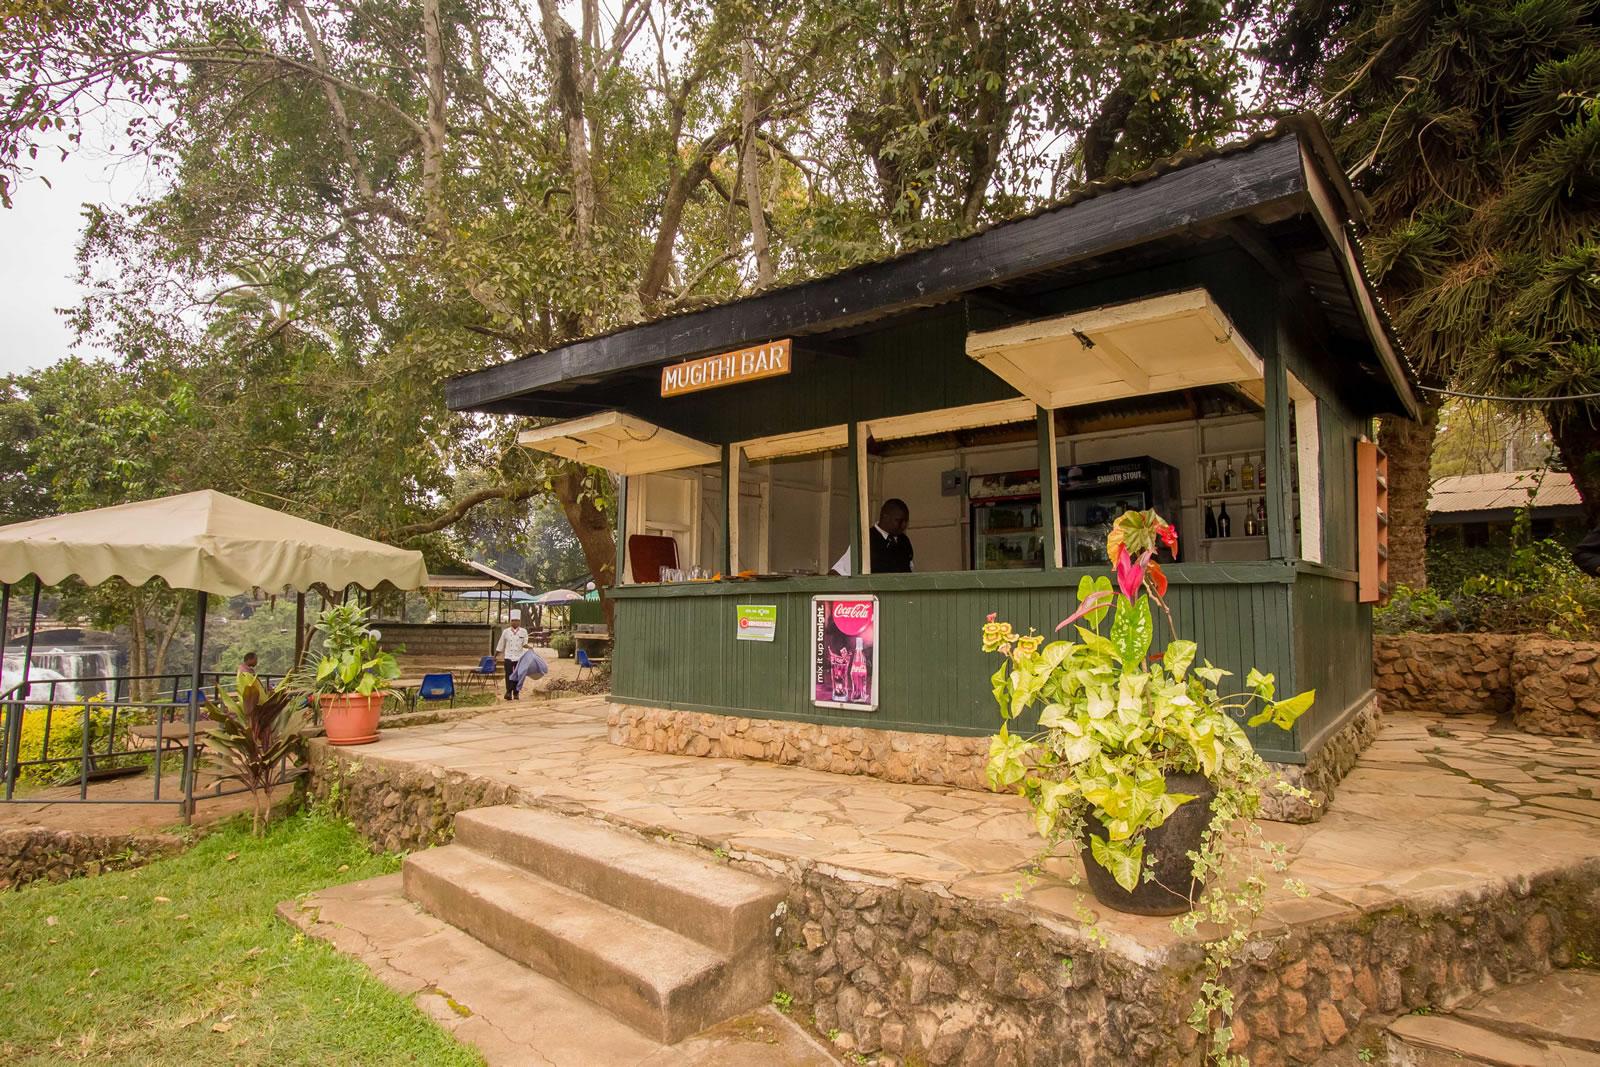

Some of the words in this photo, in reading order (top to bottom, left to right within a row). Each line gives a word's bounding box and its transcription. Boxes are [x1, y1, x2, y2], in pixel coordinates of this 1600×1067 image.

[665, 355, 736, 391] MUGITHI
[741, 345, 784, 375] BAR
[1097, 473, 1122, 483] SMOOTH
[1123, 471, 1142, 480] STOUT
[834, 603, 871, 618] Coca-Cola
[817, 643, 825, 655] up
[817, 655, 824, 664] it
